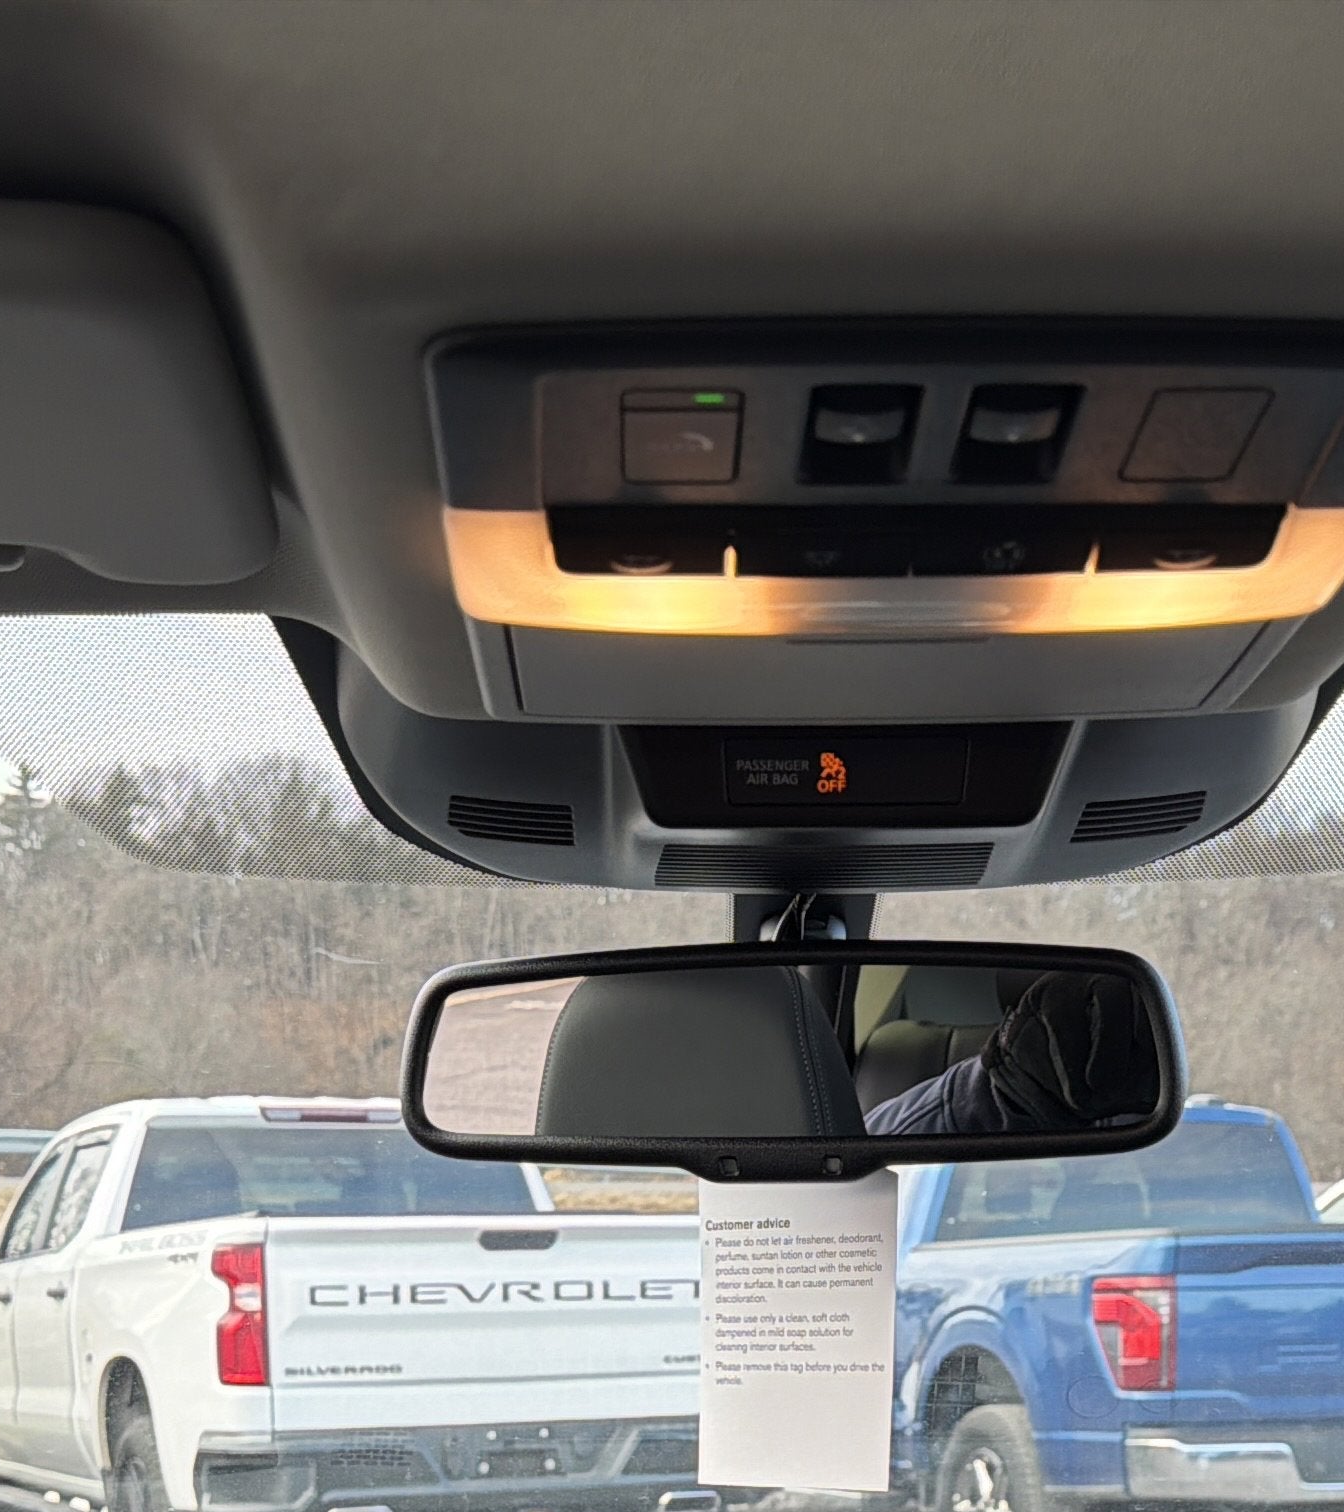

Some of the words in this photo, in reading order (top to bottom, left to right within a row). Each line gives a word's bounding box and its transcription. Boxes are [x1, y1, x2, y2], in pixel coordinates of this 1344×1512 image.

[736, 760, 810, 771] PASSENGER
[746, 773, 768, 785] AIR
[773, 773, 799, 785] BAG
[817, 779, 846, 793] OFF
[706, 1219, 753, 1231] Customer
[756, 1218, 791, 1229] advice
